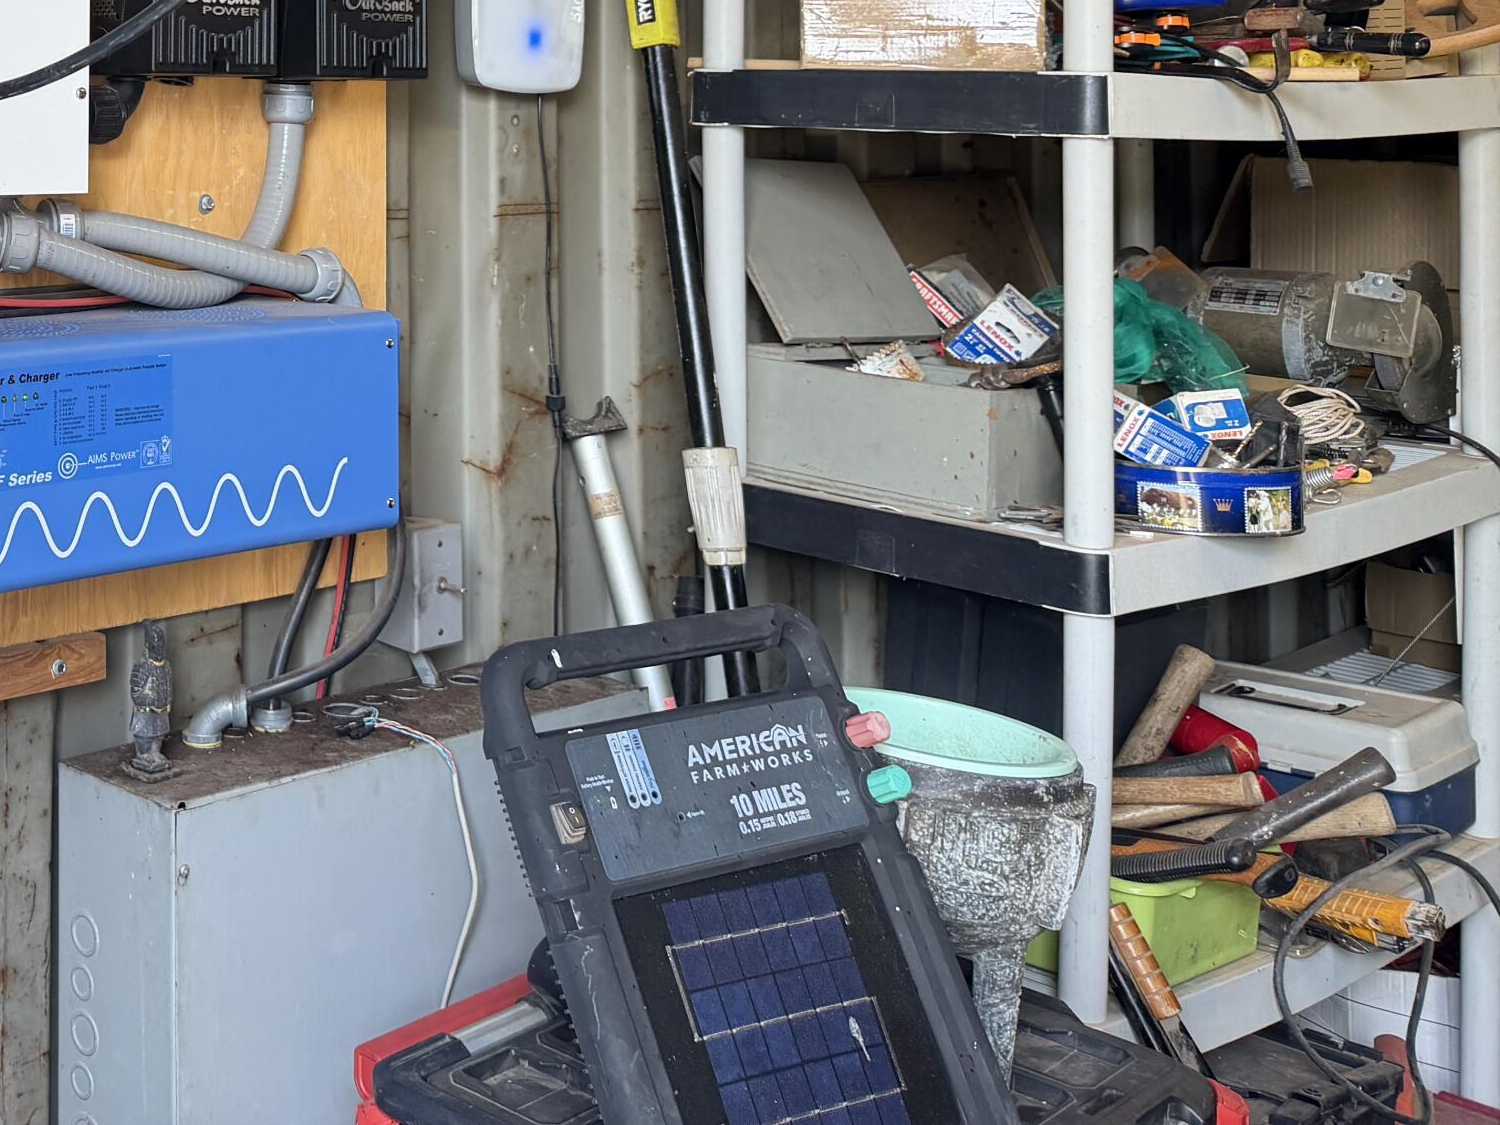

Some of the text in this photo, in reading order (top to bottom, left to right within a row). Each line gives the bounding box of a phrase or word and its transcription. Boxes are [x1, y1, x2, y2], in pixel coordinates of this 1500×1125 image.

[203, 5, 260, 17] POWER
[361, 12, 414, 23] POWER
[979, 319, 1015, 352] LENOX
[7, 374, 15, 385] &
[19, 371, 60, 384] Charger
[1116, 415, 1141, 448] LENOX
[1211, 430, 1243, 439] LENOX
[88, 452, 108, 464] AIMS
[8, 470, 53, 487] Series
[687, 723, 808, 768] AMERICAN
[730, 782, 806, 818] 10 MILES
[739, 818, 762, 835] 0.15
[777, 812, 798, 827] 0.18
